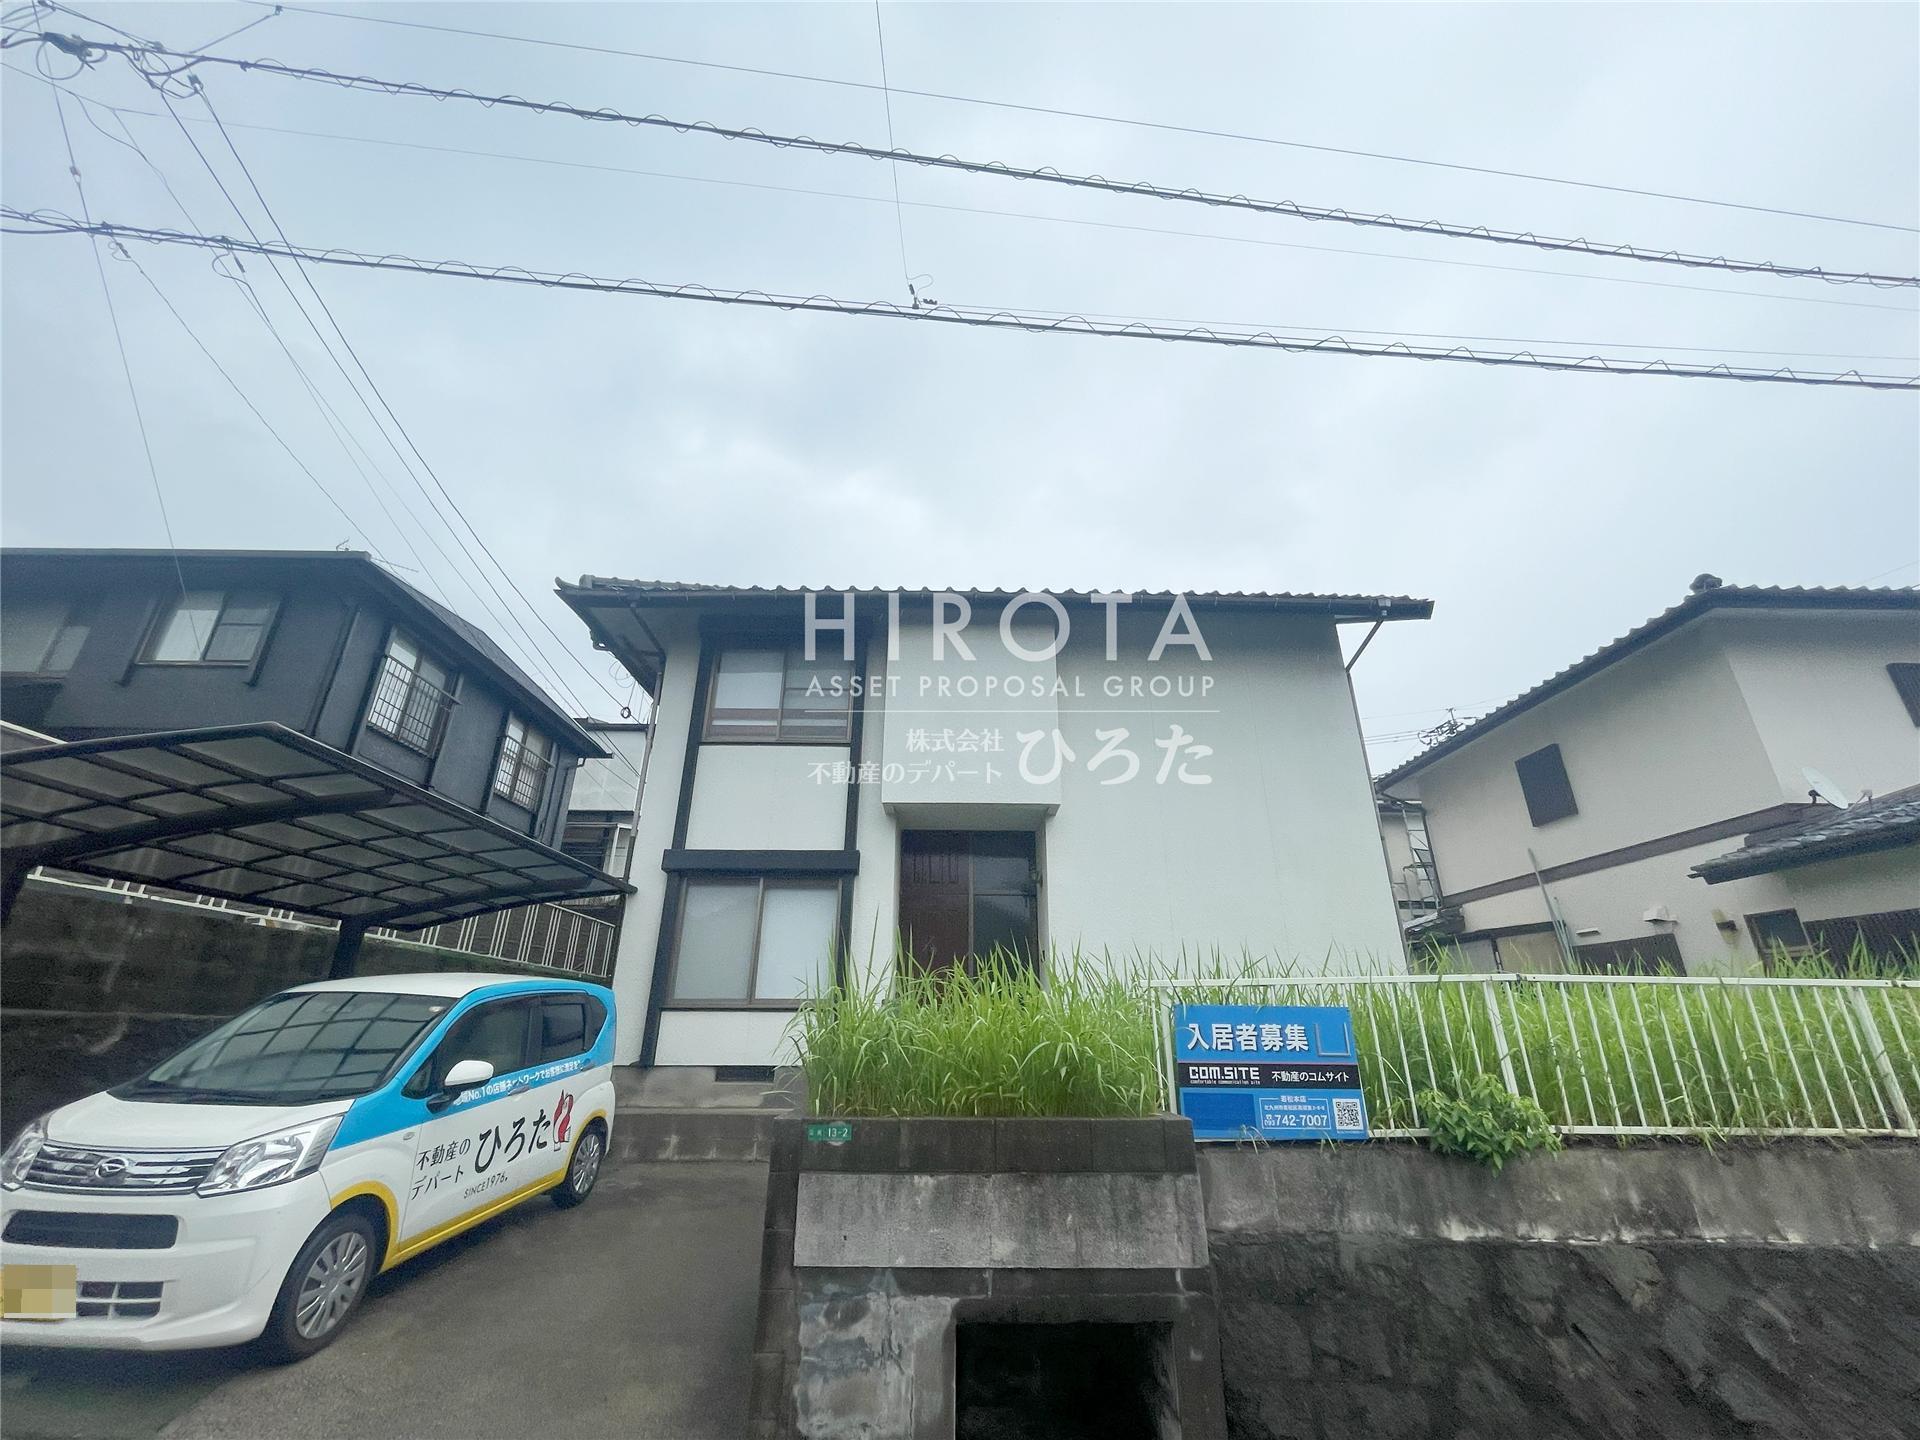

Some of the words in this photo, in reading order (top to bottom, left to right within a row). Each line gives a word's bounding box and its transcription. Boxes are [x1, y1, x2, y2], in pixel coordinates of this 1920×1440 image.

[1187, 1023, 1309, 1052] 入居者募集
[1271, 1070, 1350, 1083] 不動産のコムサイト
[1275, 1114, 1328, 1127] 742-7007
[416, 1138, 471, 1171] 不動産の
[474, 1108, 551, 1174] ひろた
[411, 1165, 464, 1200] デパート
